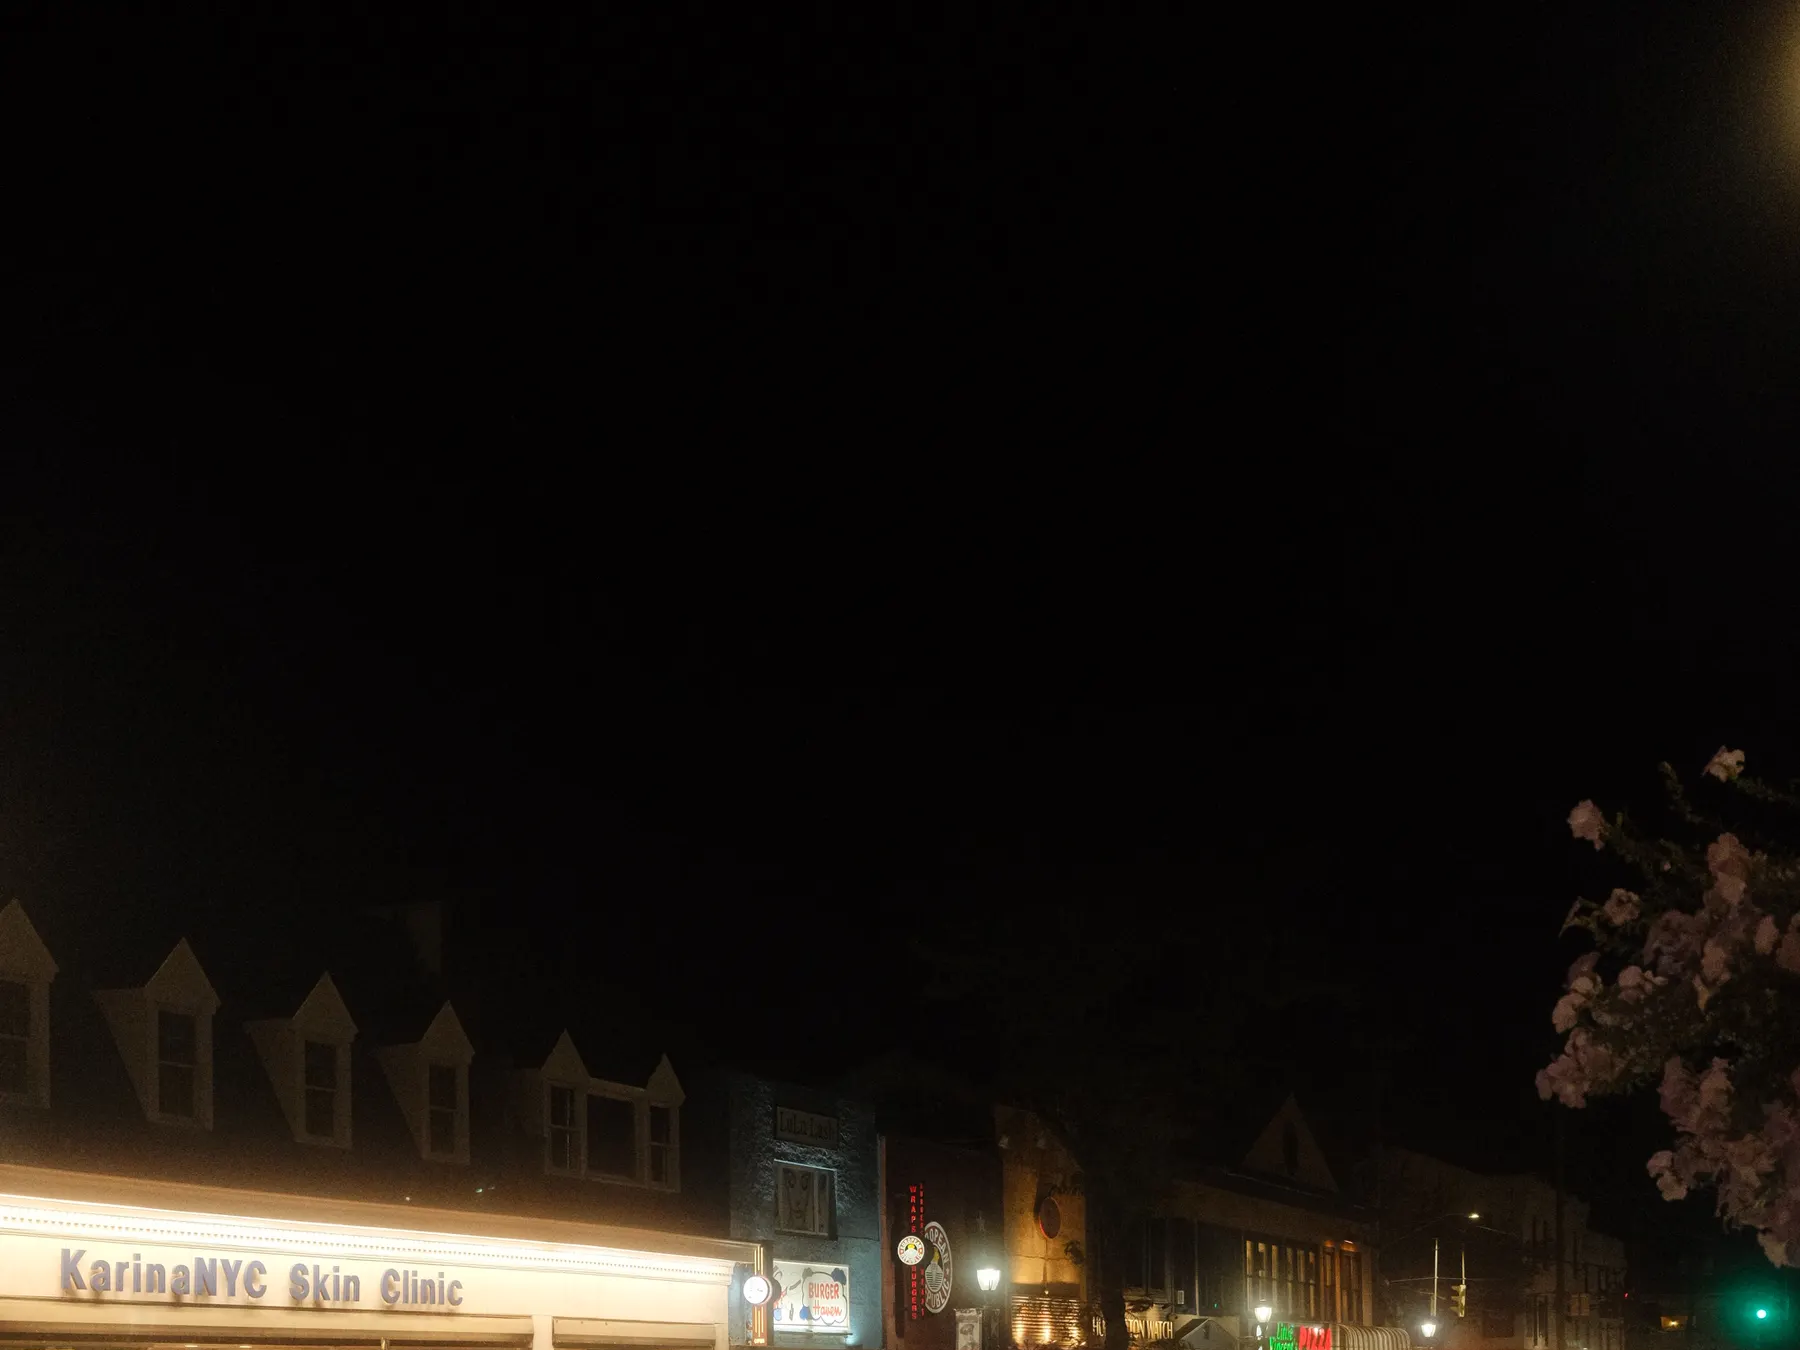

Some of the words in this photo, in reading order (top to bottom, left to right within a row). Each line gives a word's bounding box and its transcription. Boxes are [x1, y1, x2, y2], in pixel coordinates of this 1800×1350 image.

[909, 1184, 917, 1233] WRAPS
[925, 1228, 950, 1263] OPEAN
[61, 1249, 267, 1299] KarinaNYC
[289, 1263, 360, 1302] Skin
[380, 1268, 463, 1306] Clinic
[808, 1282, 840, 1300] BURGER
[813, 1300, 842, 1317] Haven
[1146, 1320, 1173, 1340] WATCH
